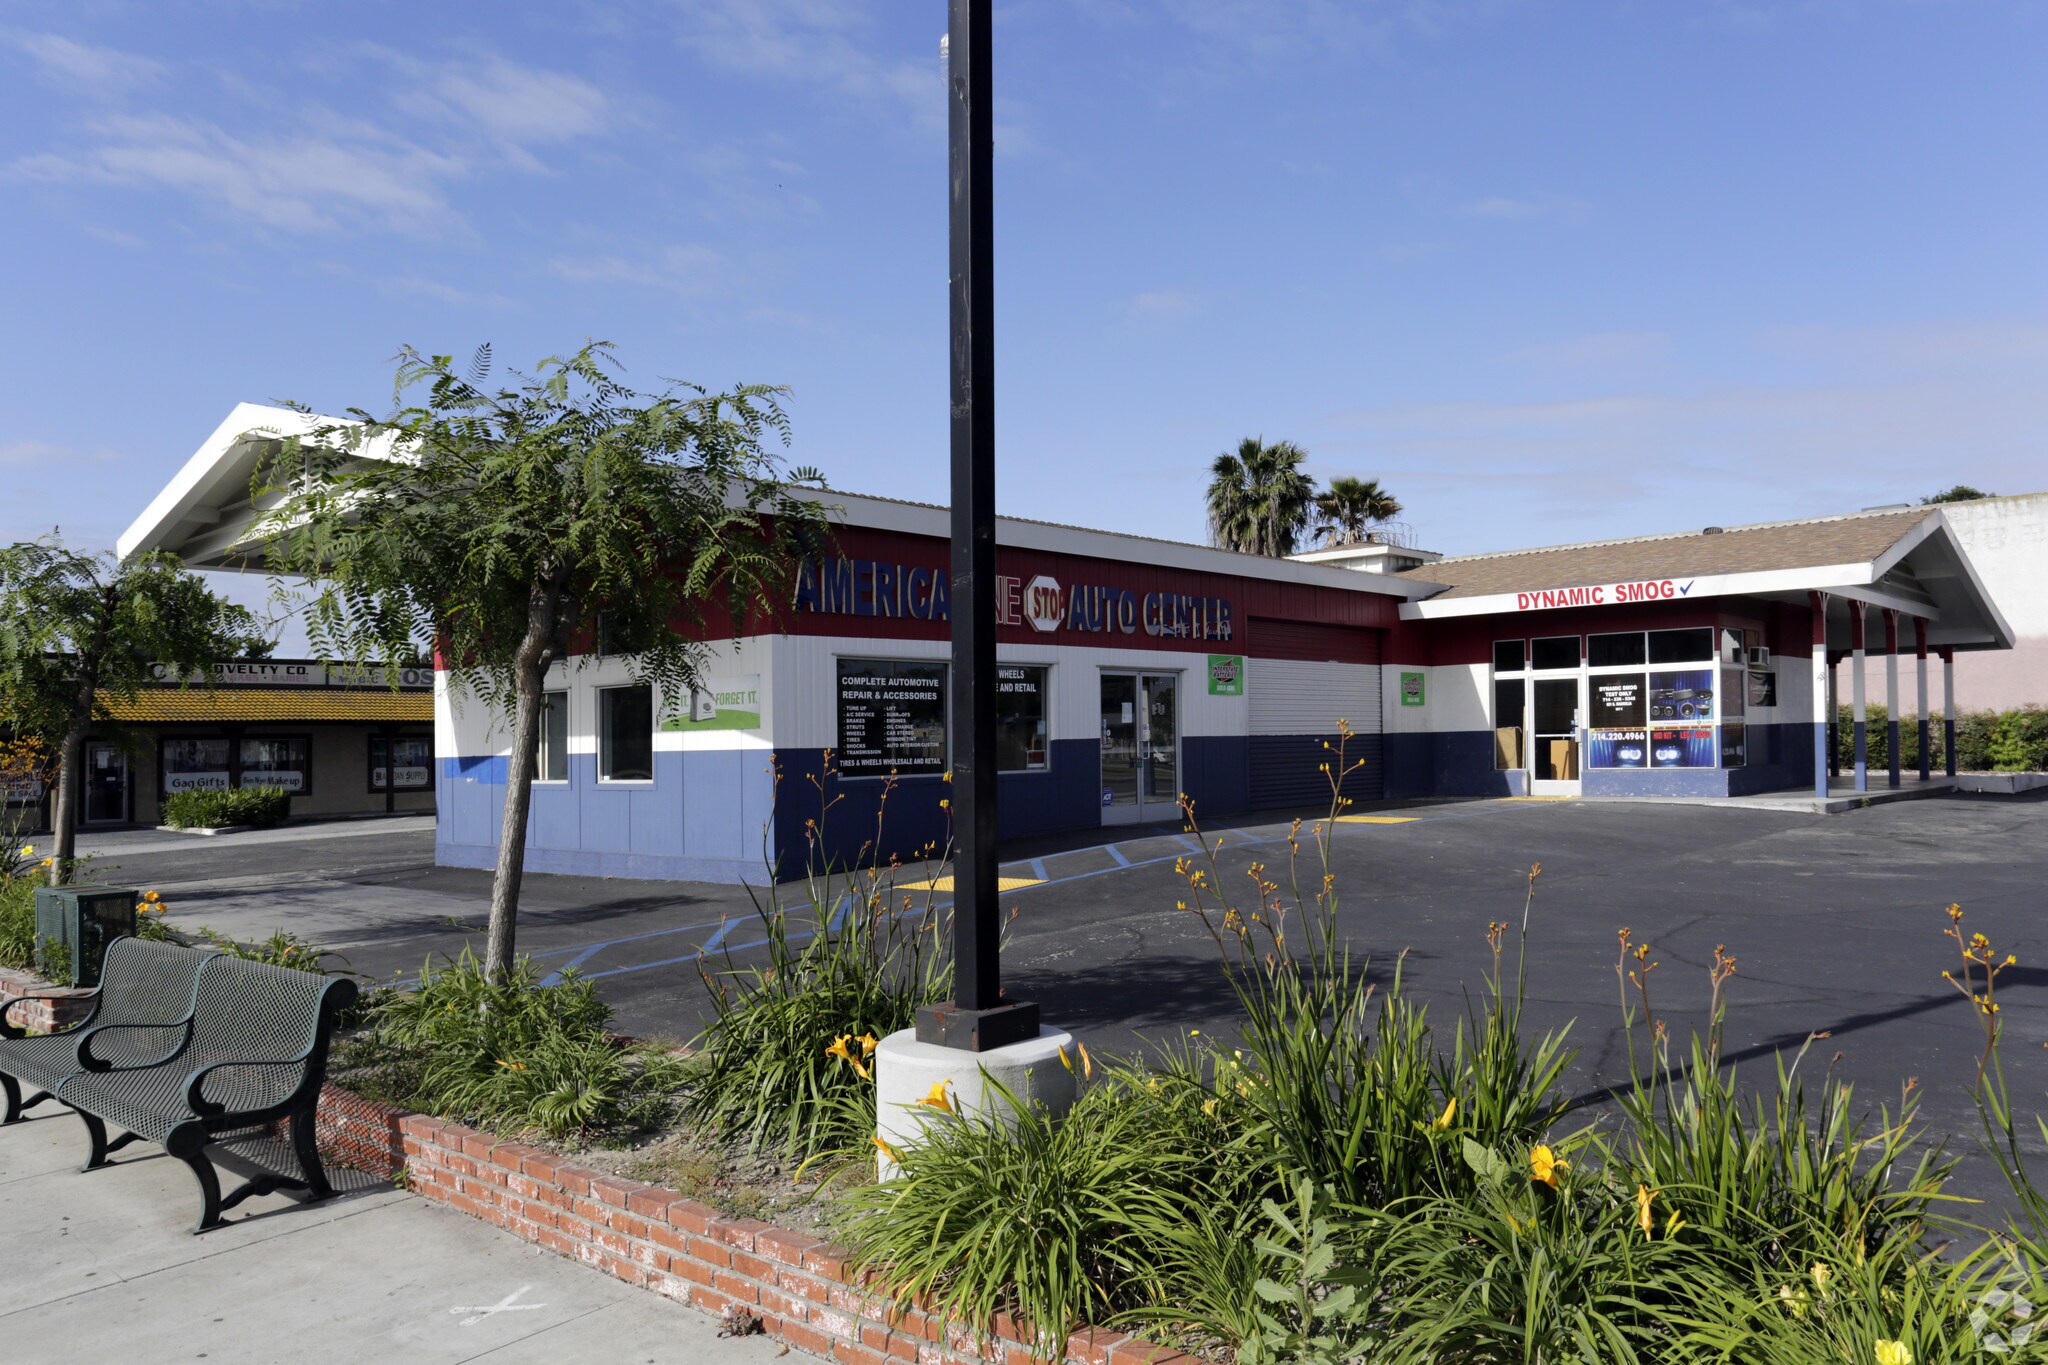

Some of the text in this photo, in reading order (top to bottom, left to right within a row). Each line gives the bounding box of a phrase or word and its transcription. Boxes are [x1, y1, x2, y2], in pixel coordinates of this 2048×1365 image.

[790, 556, 949, 621] AMERICA
[995, 575, 1020, 625] NE
[1067, 584, 1136, 634] AUTO
[1143, 591, 1233, 641] CENTER
[1517, 580, 1674, 610] DYNAMIC SMOG
[214, 664, 308, 675] OVELTY CO.
[998, 669, 1024, 679] WHEELS
[842, 677, 939, 687] COMPLETE AUTOMOTIVE
[1000, 683, 1014, 692] AND
[1015, 683, 1036, 692] RETAIL
[716, 692, 745, 705] FORGET
[842, 691, 938, 700] REPAIR & ACCESSORIES
[1592, 732, 1645, 741] 714.220.4966
[883, 758, 913, 766] WHOLESALE
[925, 757, 941, 765] RETAIL
[172, 778, 225, 789] Gag Gifts
[267, 777, 288, 785] Make
